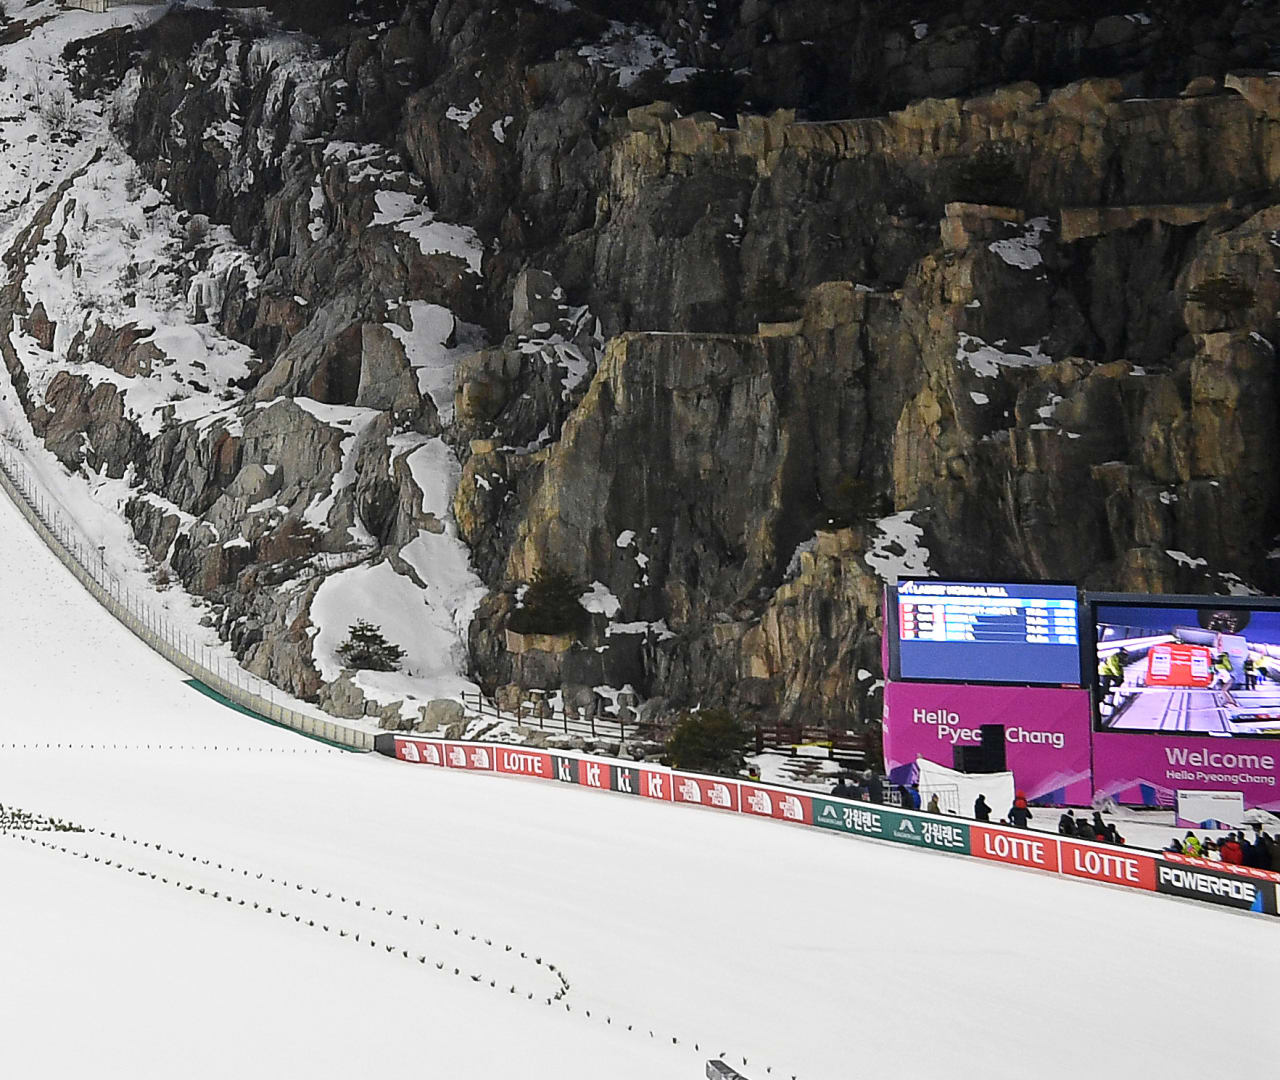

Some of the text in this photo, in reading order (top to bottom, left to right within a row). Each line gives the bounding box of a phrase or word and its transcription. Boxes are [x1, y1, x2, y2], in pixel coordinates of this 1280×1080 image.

[913, 708, 960, 725] Hello
[504, 752, 543, 774] LOTTE
[557, 757, 572, 782] kt
[1165, 748, 1274, 769] Welcome
[586, 762, 601, 788] kt
[617, 767, 632, 793] kt
[647, 772, 663, 798] kt
[1166, 770, 1276, 786] Hello PyeongChang
[842, 807, 883, 833] 강원랜드
[921, 821, 965, 848] 강원랜드
[983, 832, 1045, 864] LOTTE
[1074, 848, 1140, 882] LOTTE
[1158, 865, 1257, 903] POWERADE
